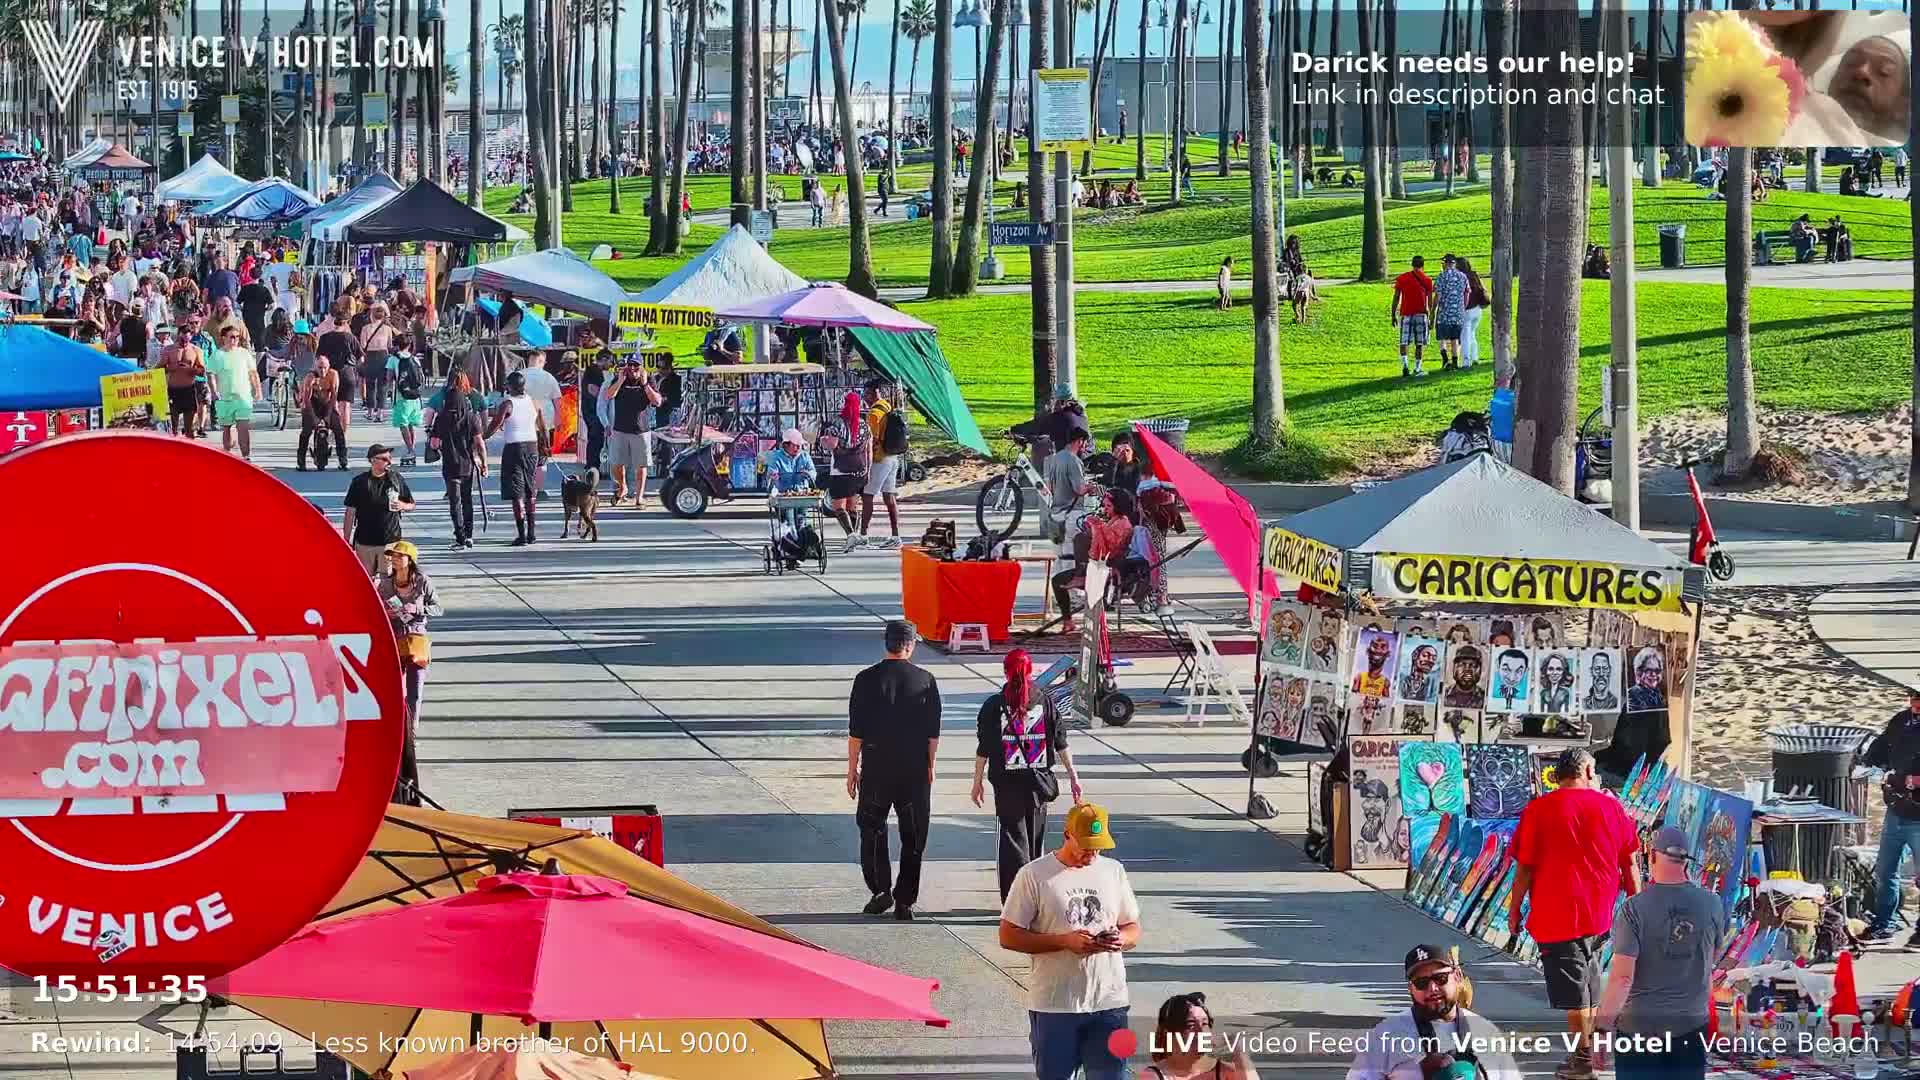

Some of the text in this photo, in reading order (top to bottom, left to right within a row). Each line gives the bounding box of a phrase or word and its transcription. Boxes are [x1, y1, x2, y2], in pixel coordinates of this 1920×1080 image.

[992, 223, 1048, 237] Horizon Av
[619, 306, 712, 328] HENNA TATTOOS
[1268, 532, 1338, 588] CARICATURES
[1393, 557, 1663, 606] CARICATURES
[41, 739, 206, 789] .com
[28, 891, 234, 949] VENICE
